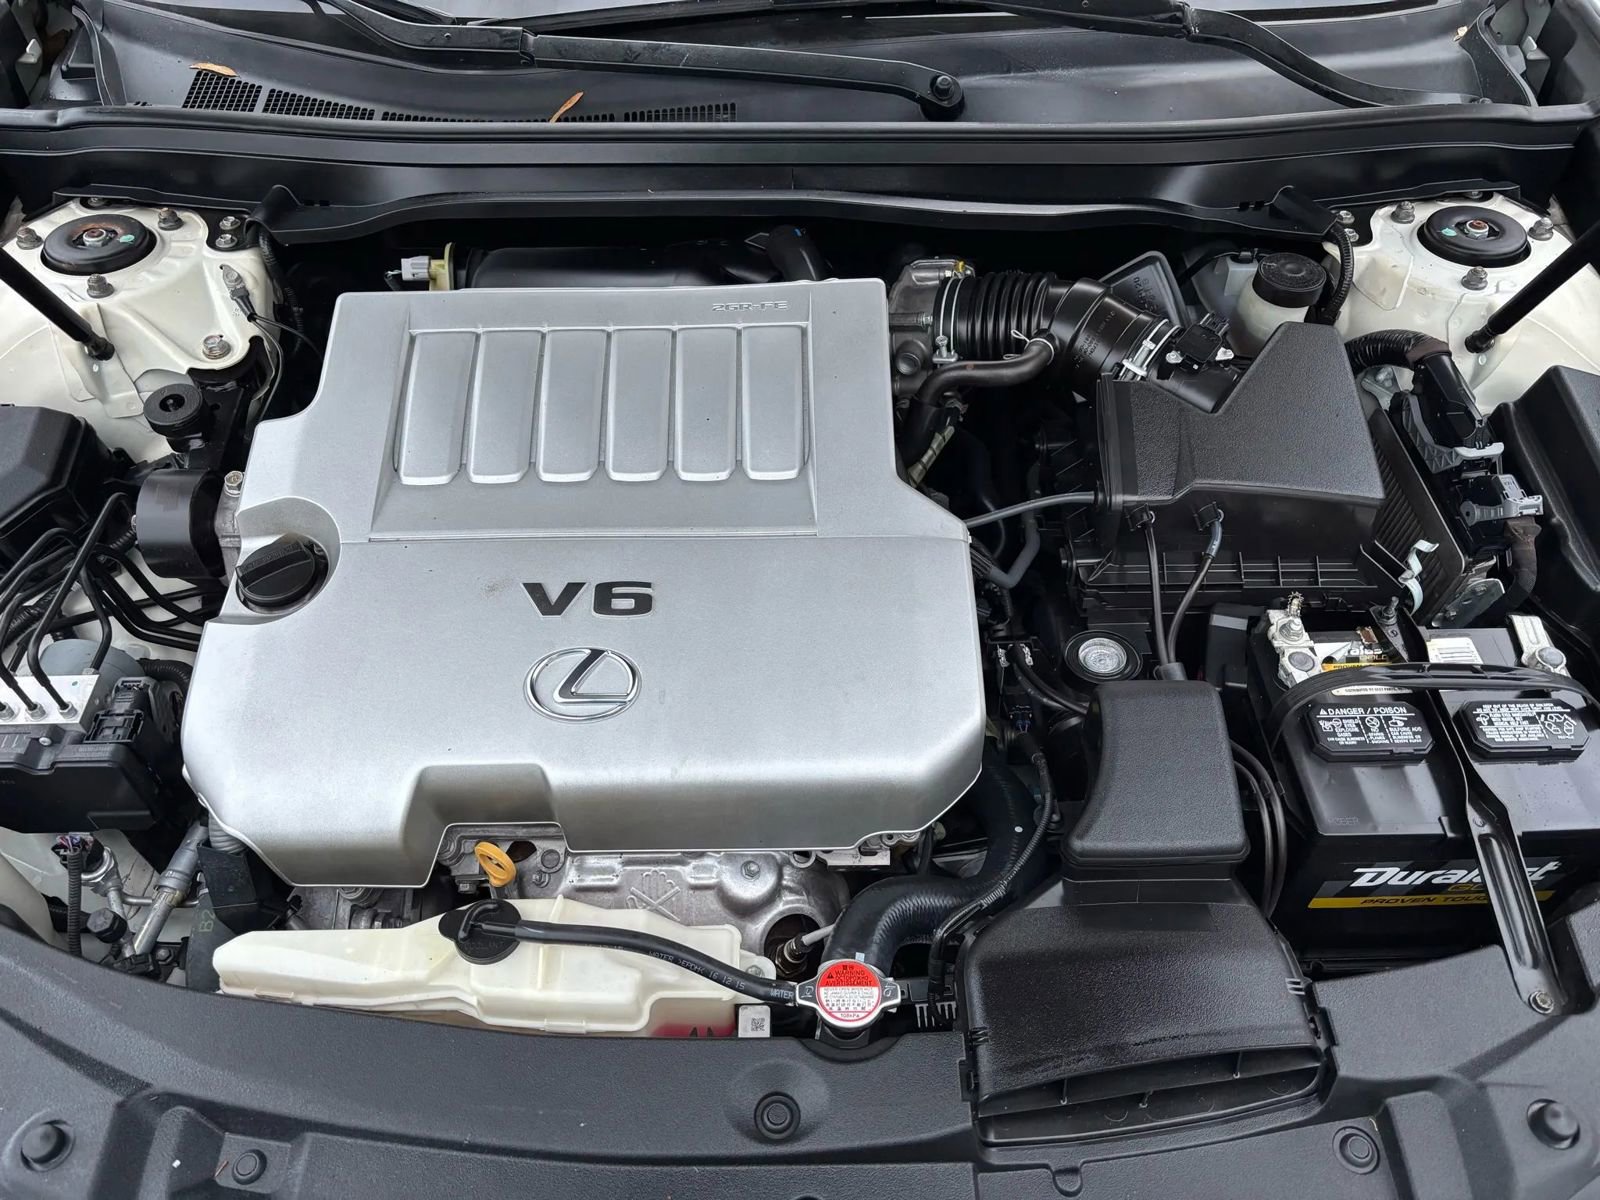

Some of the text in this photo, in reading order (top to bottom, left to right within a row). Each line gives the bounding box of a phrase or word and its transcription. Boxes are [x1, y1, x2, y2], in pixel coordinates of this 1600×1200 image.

[712, 300, 788, 312] 2GR-FE
[521, 580, 653, 618] V6
[1328, 707, 1365, 715] DANGER
[1373, 706, 1407, 714] POISON
[1350, 861, 1562, 887] Duralt
[1361, 895, 1488, 905] PROVEN TOUG
[709, 970, 719, 980] 16
[723, 975, 732, 984] 12
[735, 980, 745, 990] 15
[770, 989, 794, 999] WATER
